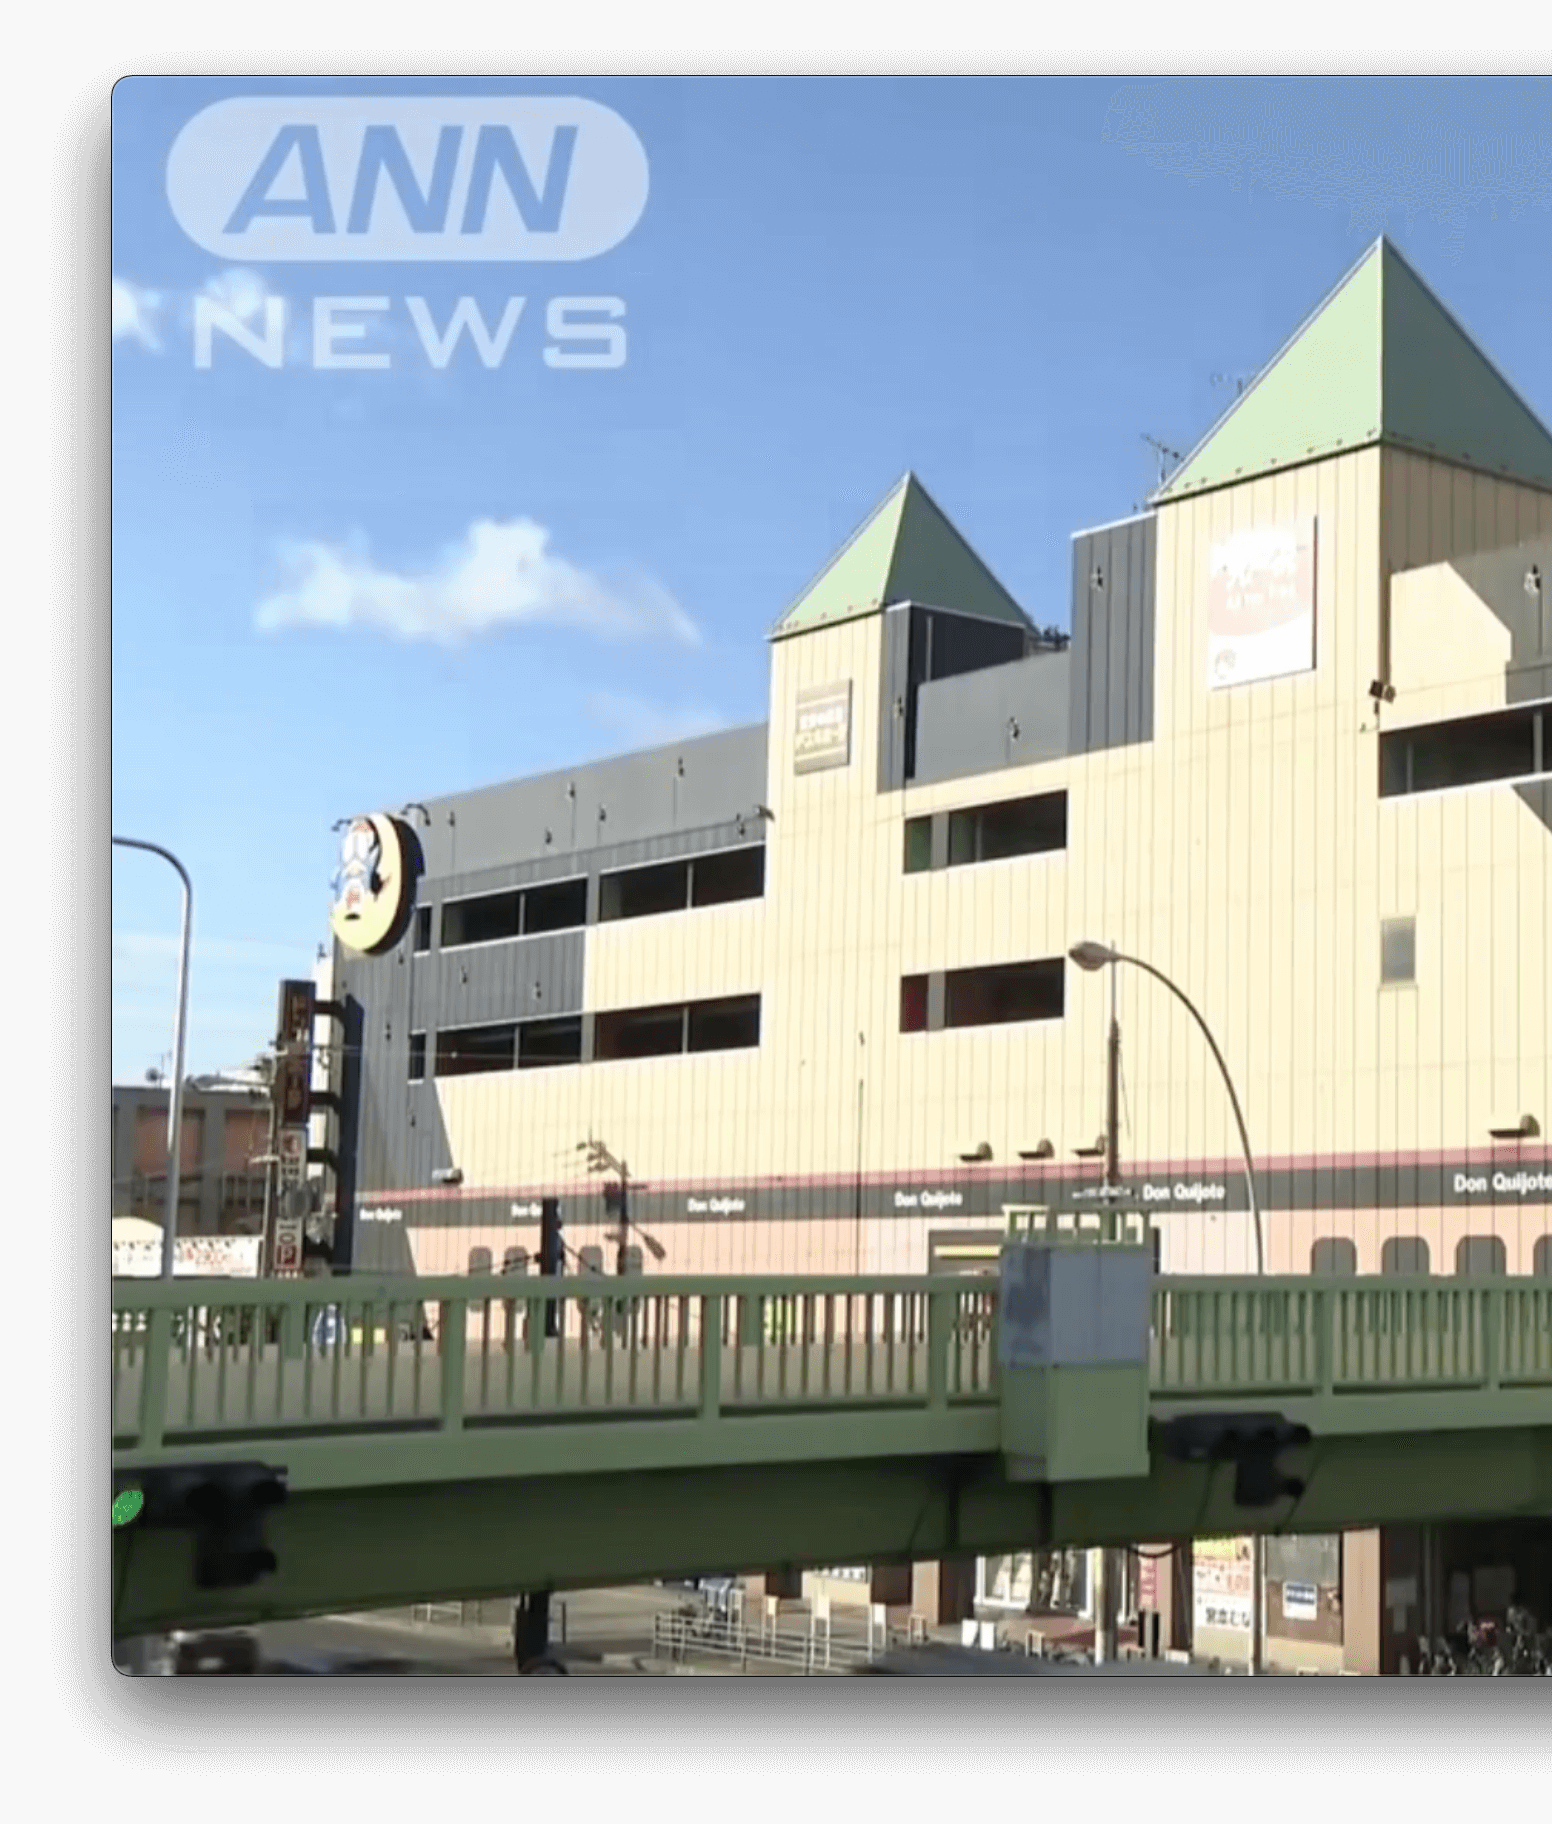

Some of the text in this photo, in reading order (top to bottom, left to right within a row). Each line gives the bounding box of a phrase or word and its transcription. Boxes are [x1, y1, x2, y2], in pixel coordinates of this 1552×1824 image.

[1142, 1182, 1225, 1204] Don Quijote
[1454, 1173, 1488, 1193] Don
